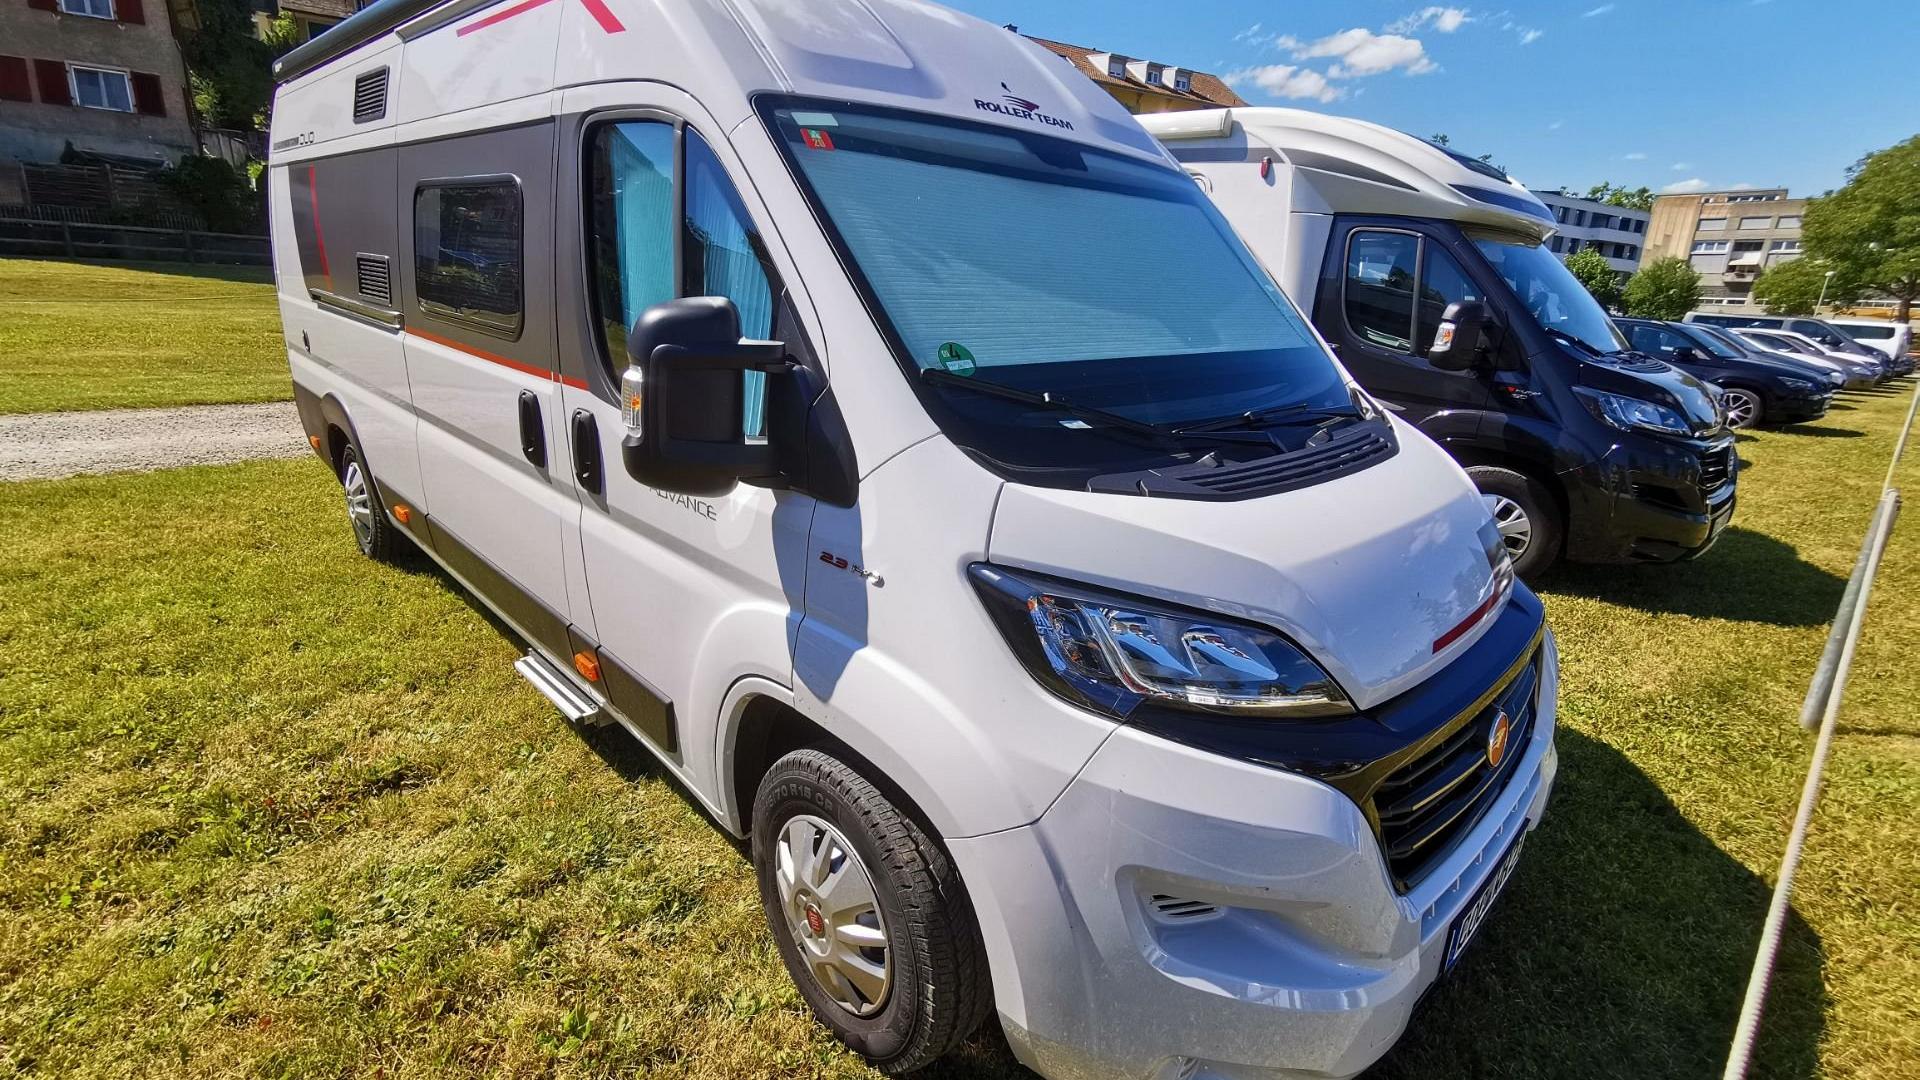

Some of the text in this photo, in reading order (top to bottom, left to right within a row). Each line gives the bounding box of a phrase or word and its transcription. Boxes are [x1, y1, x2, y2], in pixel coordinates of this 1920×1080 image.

[974, 98, 1074, 131] ROLLER TEAM
[650, 487, 717, 521] DVANCE
